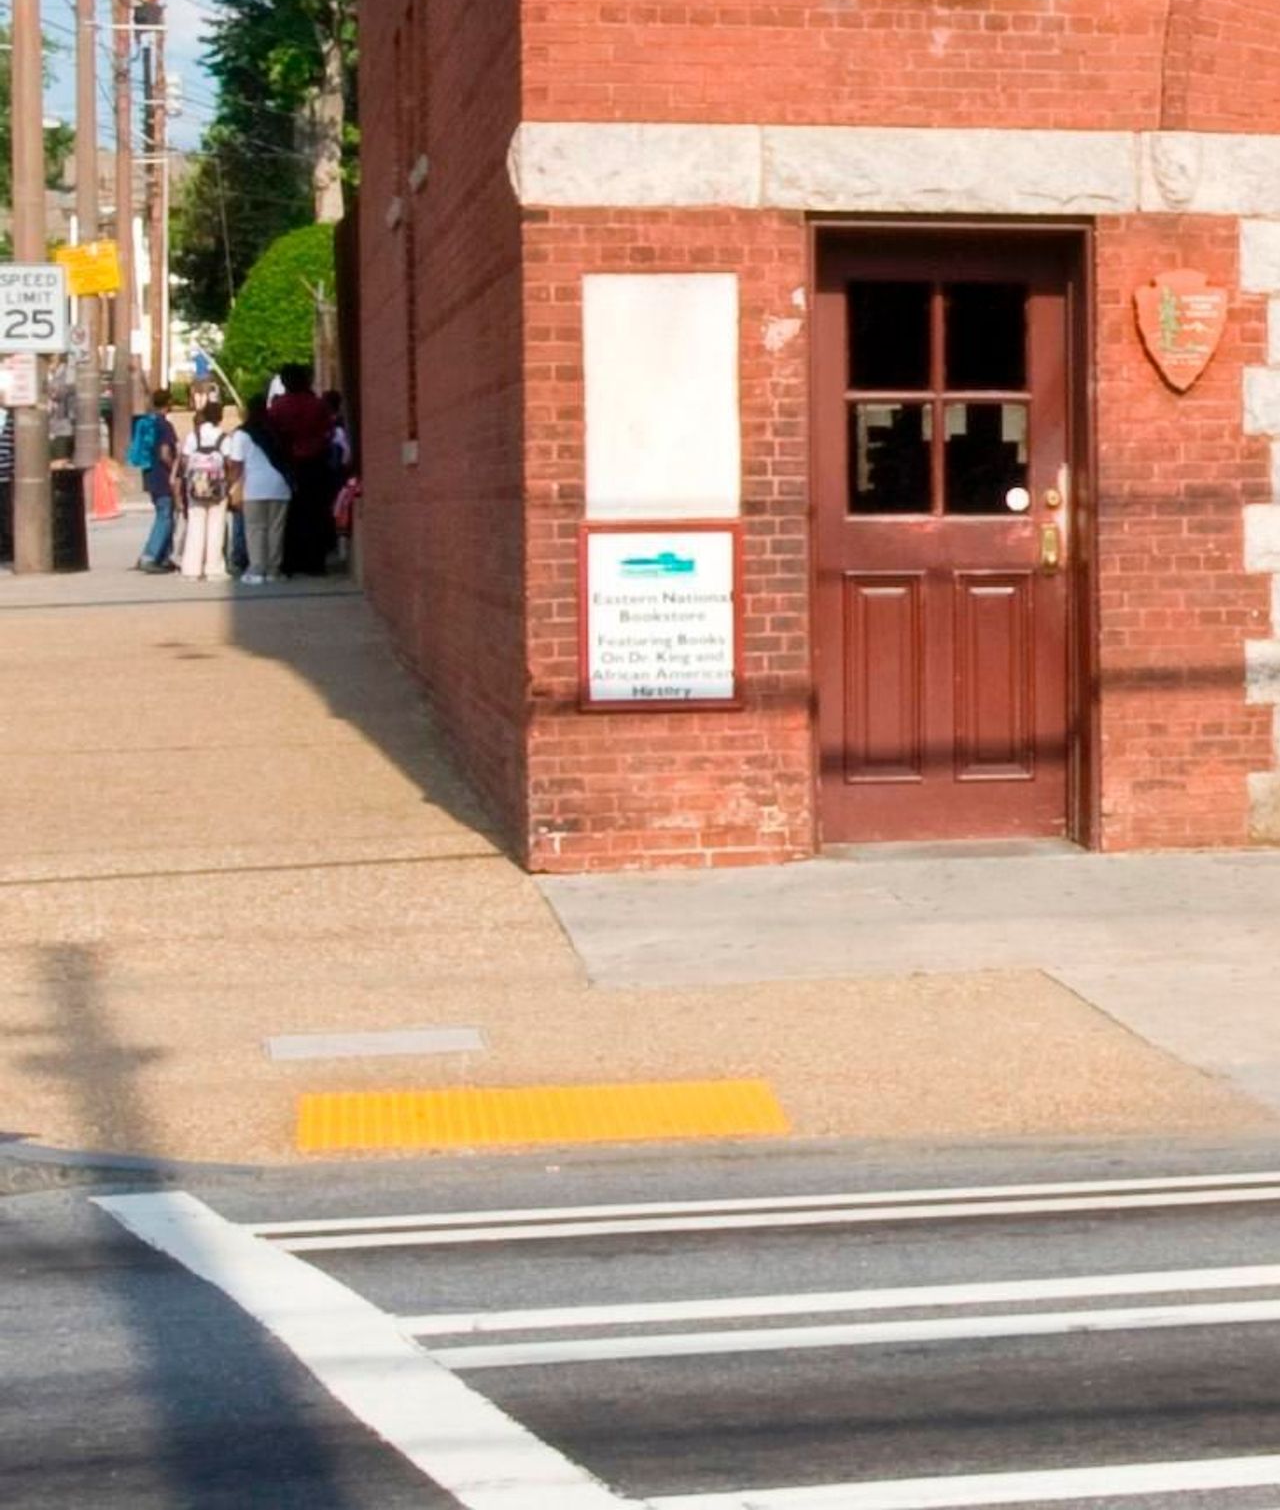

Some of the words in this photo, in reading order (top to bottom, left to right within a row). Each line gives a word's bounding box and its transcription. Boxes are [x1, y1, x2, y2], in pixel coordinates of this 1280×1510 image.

[0, 273, 57, 287] SPEED
[5, 291, 52, 305] LIMIT
[4, 309, 55, 339] 25
[593, 592, 657, 605] Eastern
[619, 609, 707, 623] Bookstore
[598, 633, 673, 649] Featuring
[677, 633, 725, 647] Books
[601, 651, 624, 663] On
[656, 651, 690, 665] King
[696, 650, 724, 663] and
[592, 669, 651, 682] African
[631, 685, 692, 699] History
